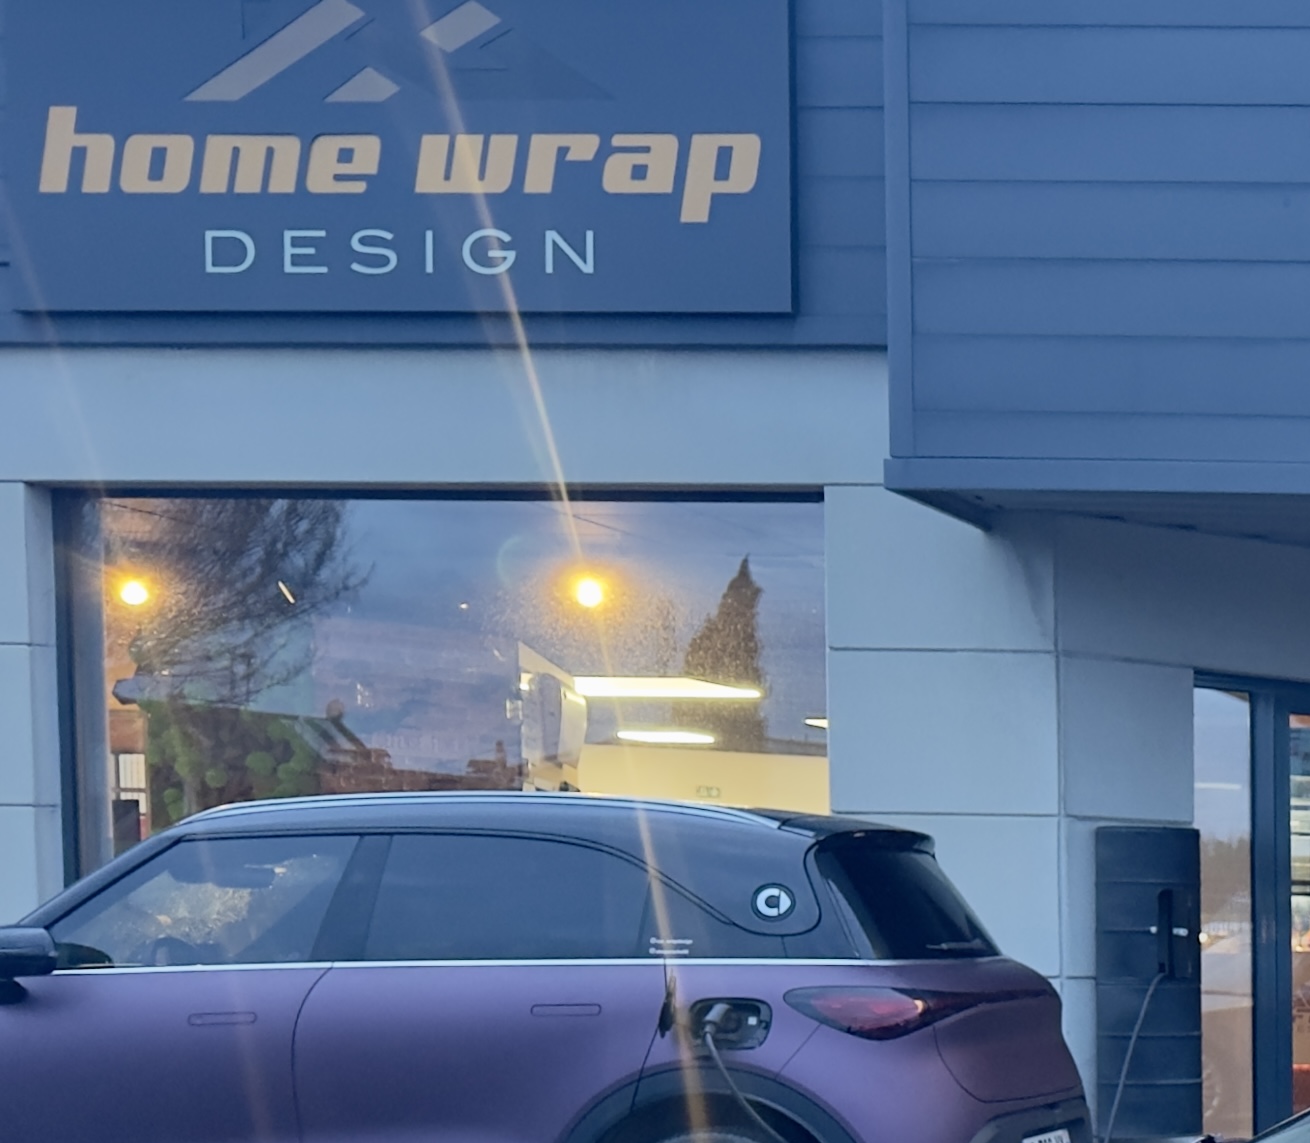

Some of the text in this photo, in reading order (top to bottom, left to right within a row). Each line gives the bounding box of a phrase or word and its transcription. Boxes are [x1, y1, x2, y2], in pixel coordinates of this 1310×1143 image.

[37, 104, 763, 224] home wrap
[203, 227, 597, 275] DESIGN
